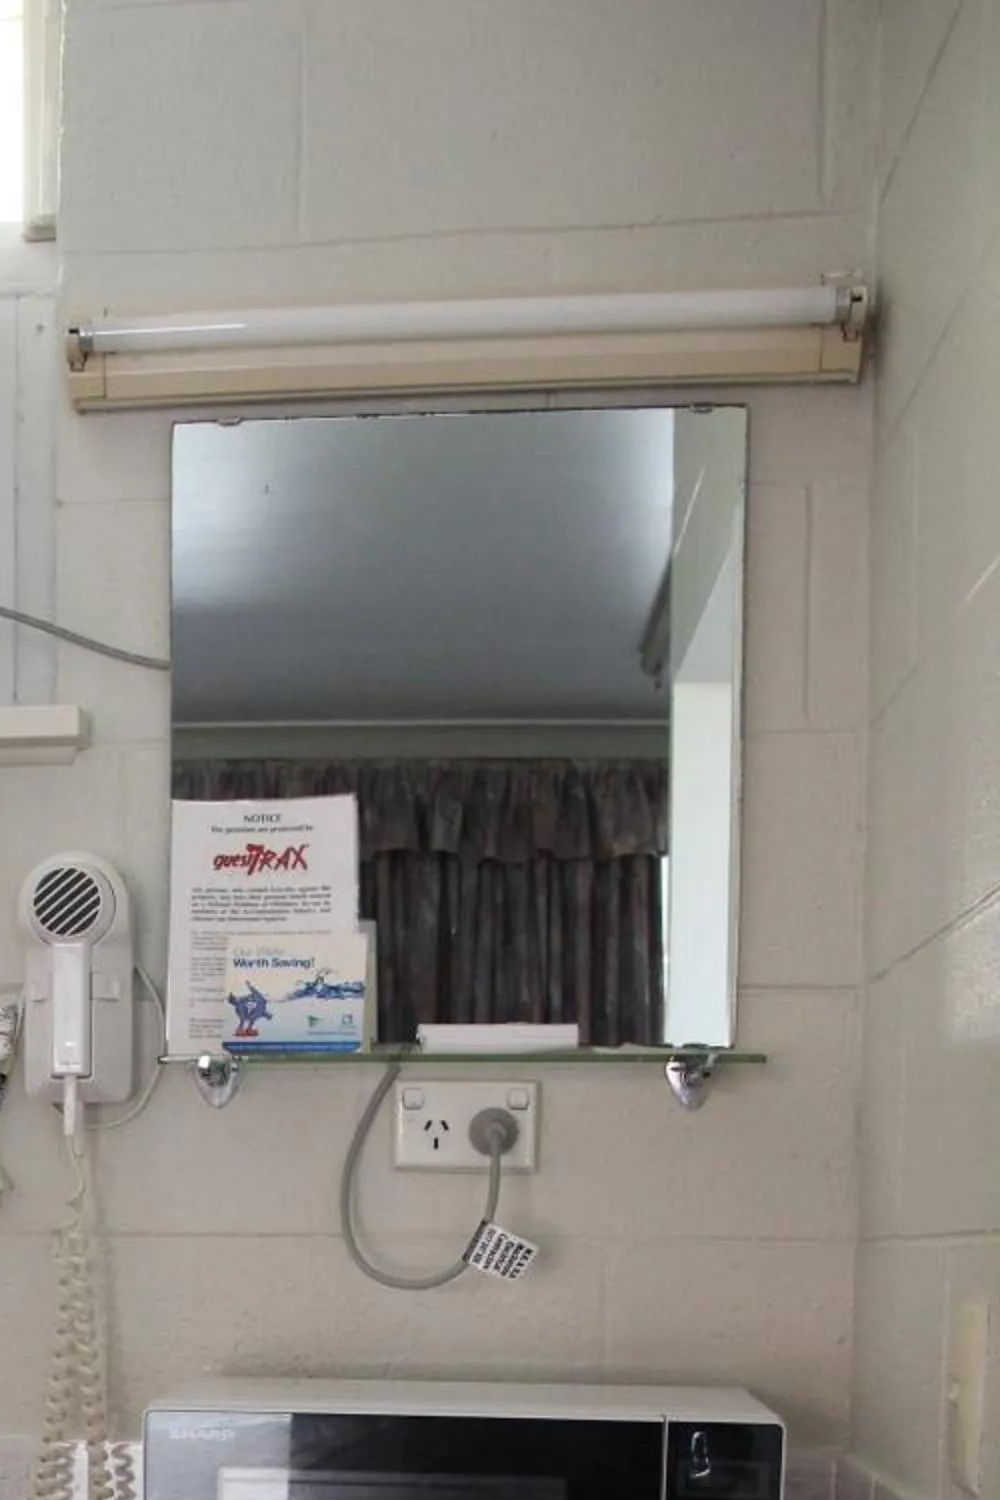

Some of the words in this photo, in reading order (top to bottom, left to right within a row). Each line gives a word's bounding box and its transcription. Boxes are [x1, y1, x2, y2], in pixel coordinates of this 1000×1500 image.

[244, 814, 281, 823] NOTICE
[233, 957, 269, 969] Worth
[271, 956, 315, 970] Saving!
